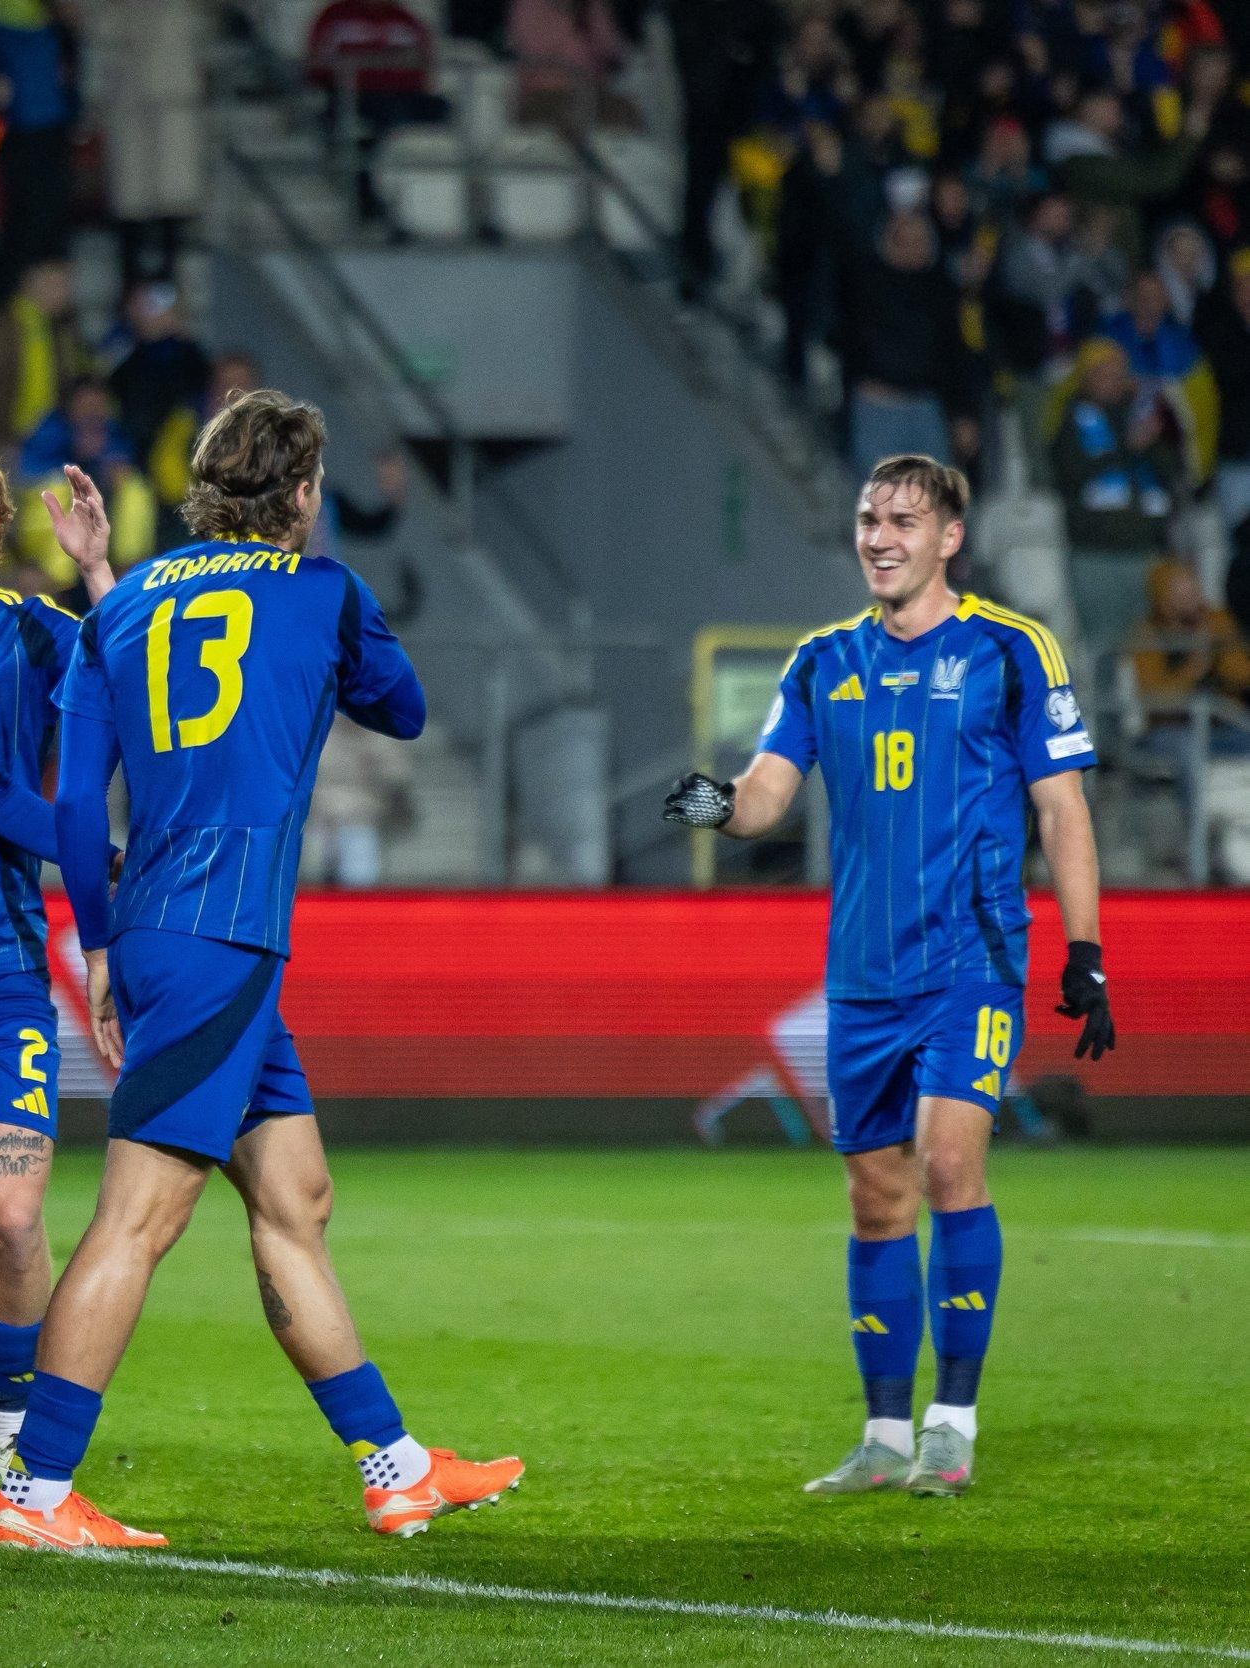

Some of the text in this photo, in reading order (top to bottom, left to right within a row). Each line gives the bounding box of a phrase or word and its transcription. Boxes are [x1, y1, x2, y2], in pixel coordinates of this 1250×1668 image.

[142, 551, 301, 590] ZABARNYI
[146, 589, 254, 753] 13
[873, 730, 916, 792] 18
[17, 1027, 49, 1084] 2
[974, 1004, 1013, 1068] 18
